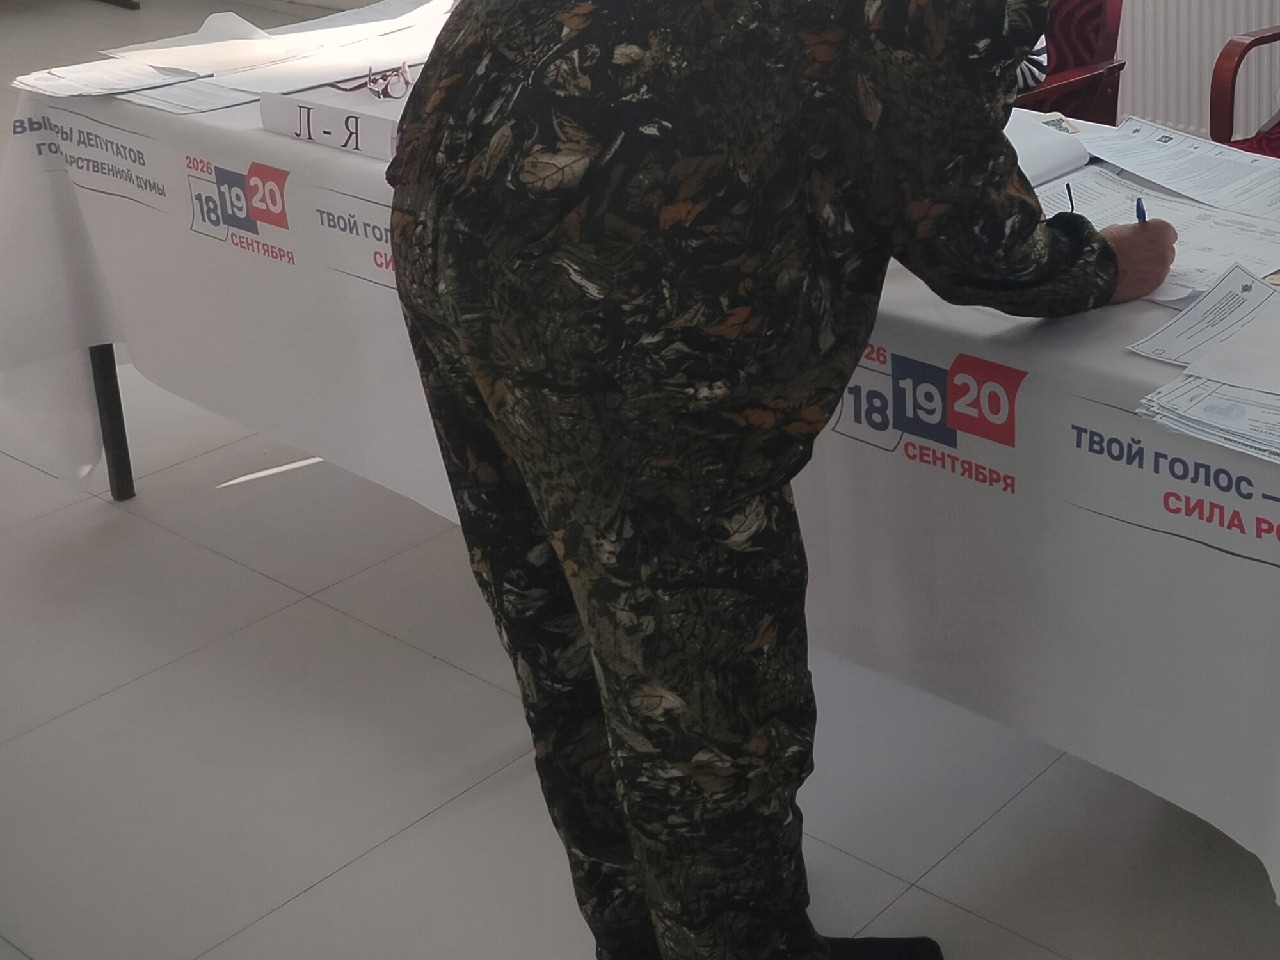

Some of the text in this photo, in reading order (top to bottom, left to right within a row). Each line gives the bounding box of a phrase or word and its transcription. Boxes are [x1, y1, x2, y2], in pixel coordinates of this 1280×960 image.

[295, 105, 315, 140] Л
[340, 115, 361, 152] Я
[77, 129, 146, 166] ДЕПУТАТОВ
[186, 156, 213, 175] 2026
[135, 174, 167, 197] ДУМЫ
[195, 177, 283, 227] 18 19 20
[316, 209, 391, 244] ТВОЙ ГОЛ
[230, 232, 295, 265] СЕНТЯБРЯ
[373, 251, 397, 272] СИ
[864, 343, 887, 365] 26
[848, 373, 1009, 431] 18 19 20
[903, 441, 1016, 494] СЕНТЯБРЯ
[1071, 424, 1144, 469] ТВОЙ
[1153, 451, 1255, 500] ГОЛОС
[1163, 491, 1246, 535] СИЛА
